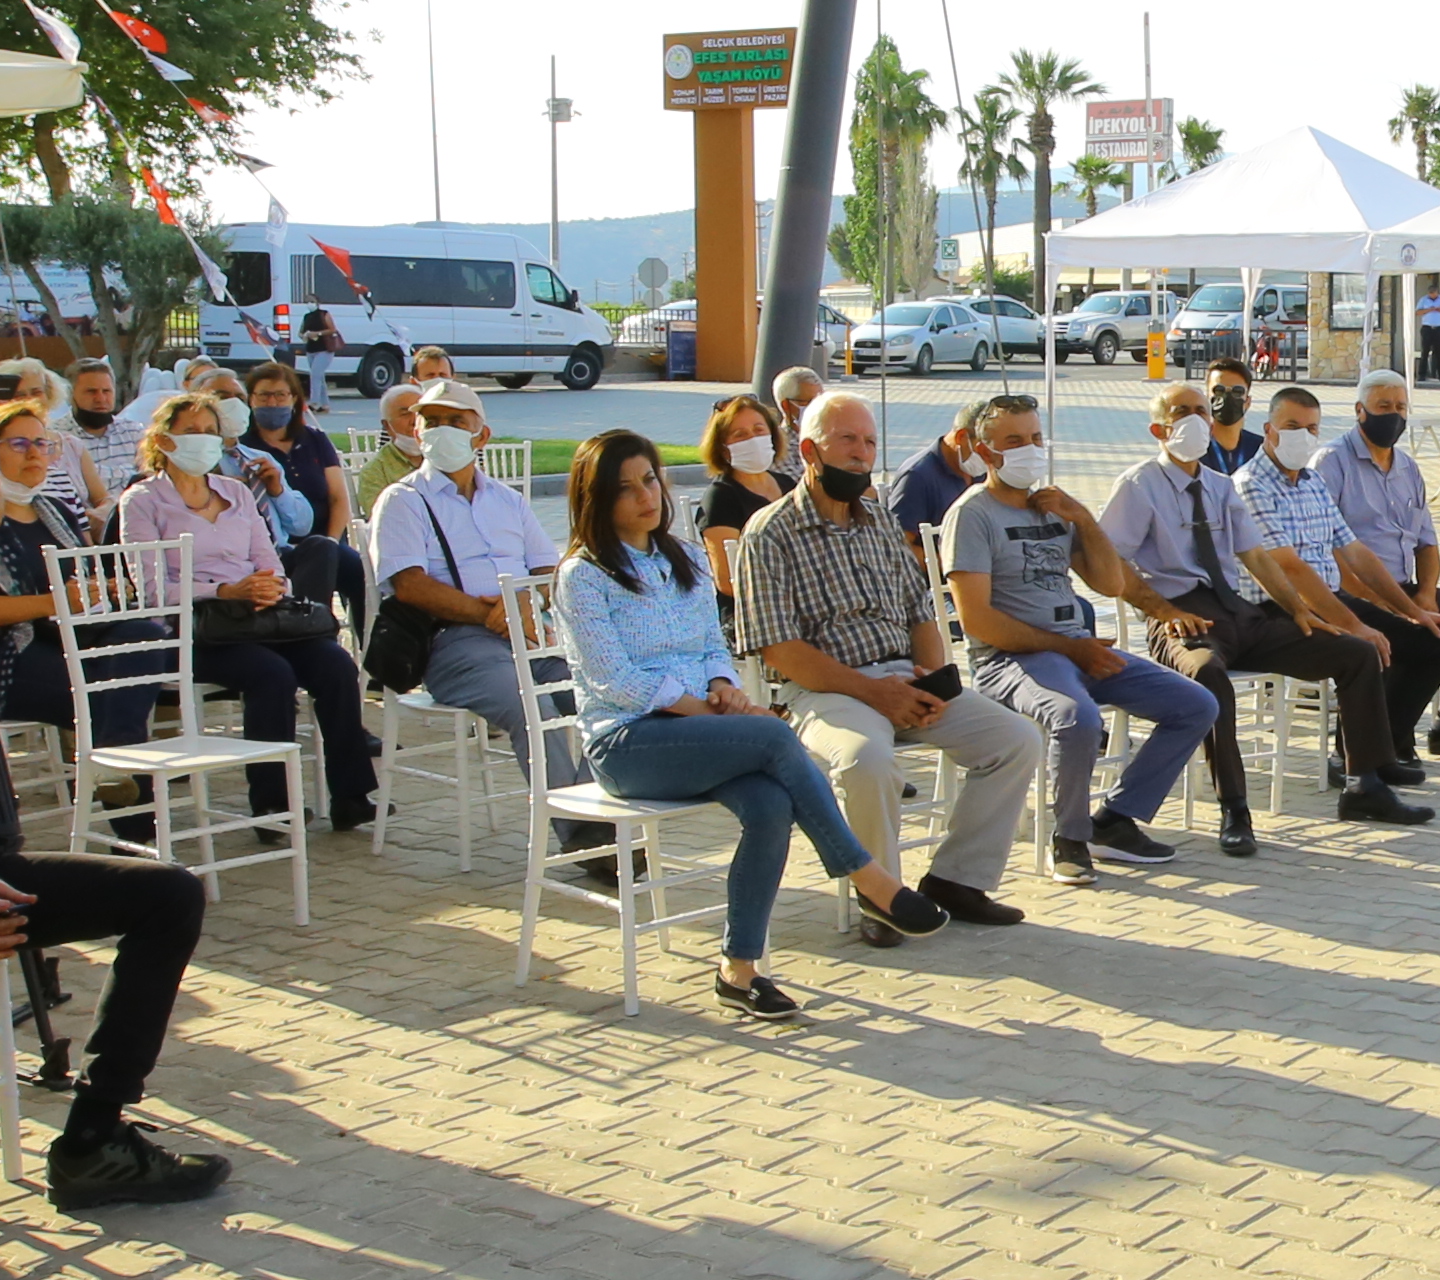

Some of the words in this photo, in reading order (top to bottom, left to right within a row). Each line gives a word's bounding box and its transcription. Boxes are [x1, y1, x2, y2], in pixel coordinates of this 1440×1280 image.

[702, 38, 736, 48] SELÇUK
[736, 34, 785, 46] BELEDİYESİ
[694, 51, 727, 64] EFES
[730, 49, 788, 61] TARLASI
[698, 70, 741, 84] YAŞAM
[745, 64, 782, 81] KÖYÜ
[1087, 141, 1156, 158] RESTAURA
